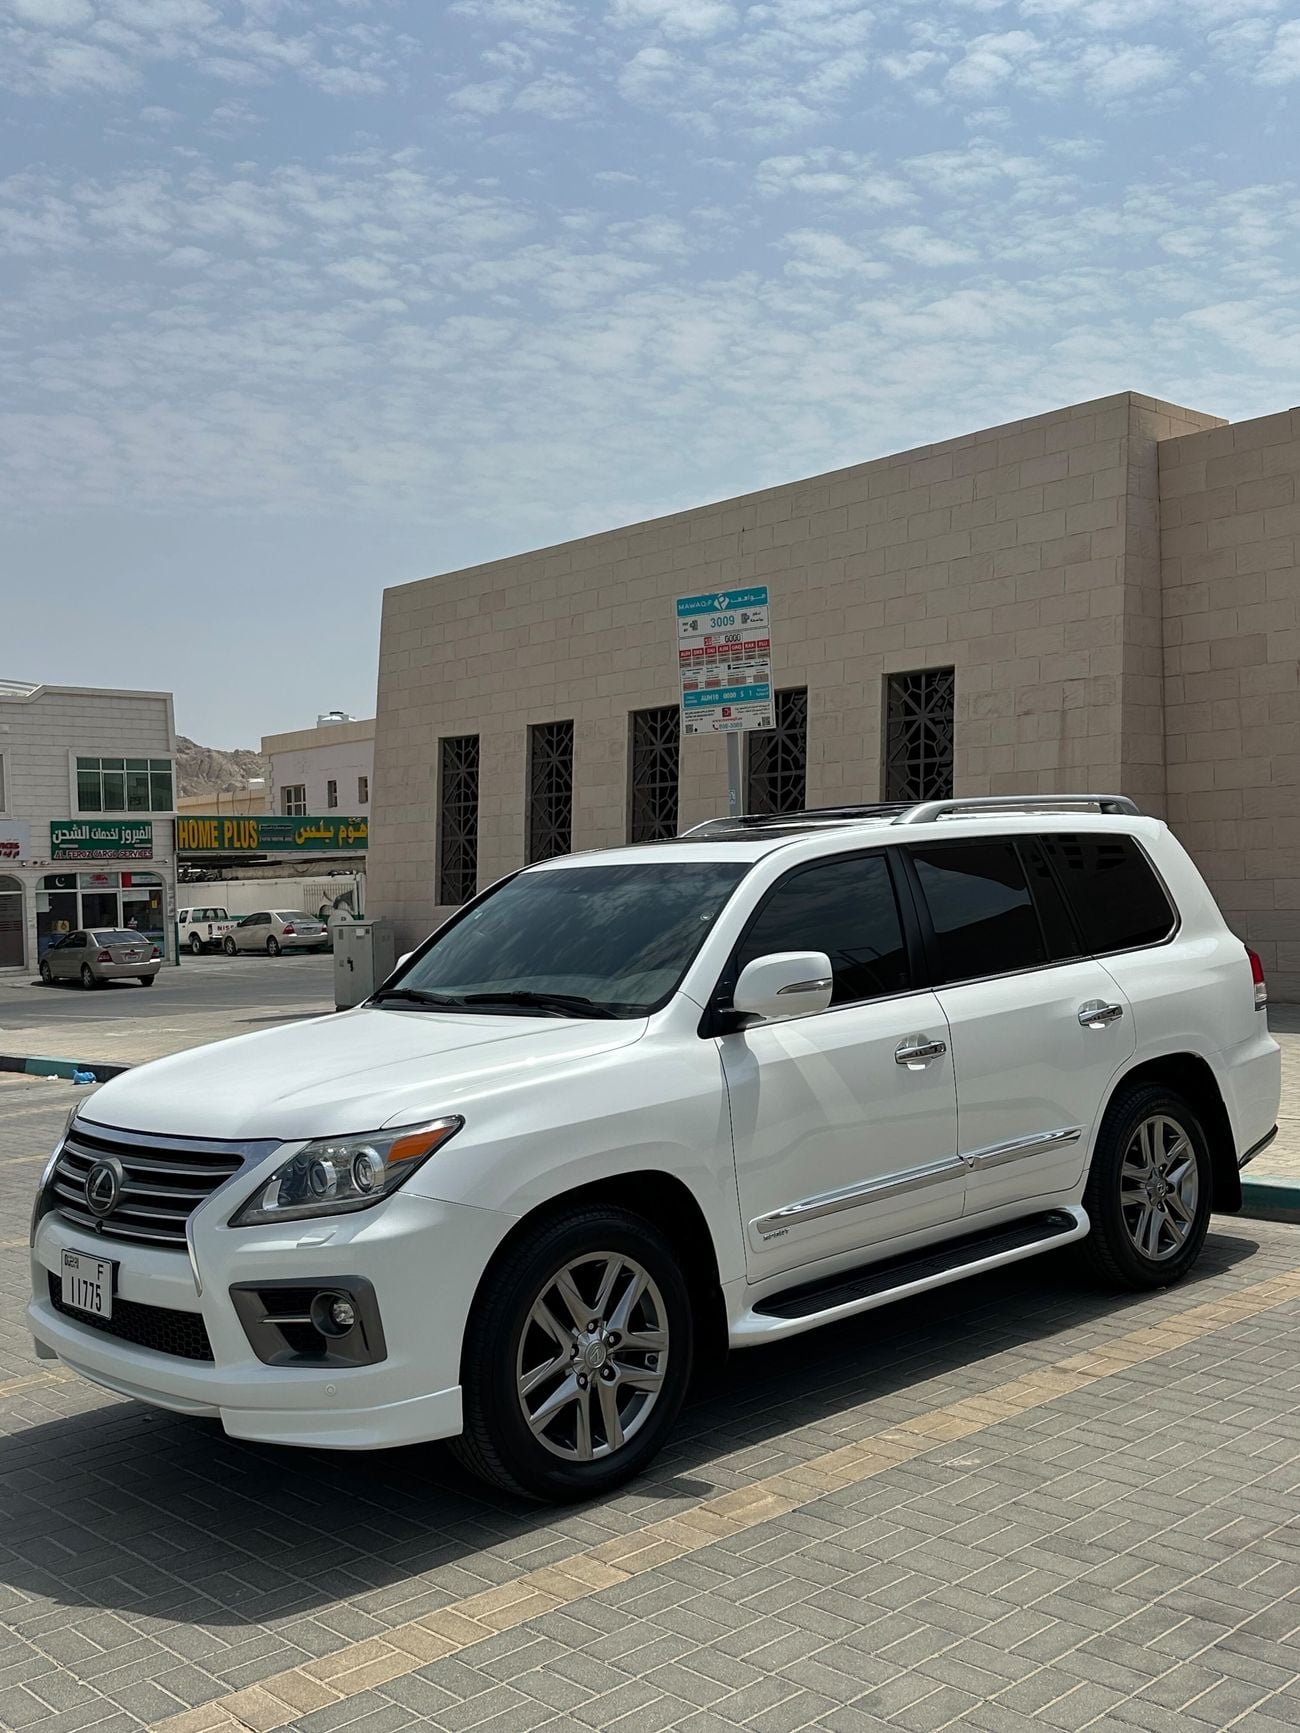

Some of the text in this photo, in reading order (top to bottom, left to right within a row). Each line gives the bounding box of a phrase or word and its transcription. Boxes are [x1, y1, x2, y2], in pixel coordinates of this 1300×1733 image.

[710, 615, 735, 628] 3009
[52, 823, 152, 844] الفيروز لخدمات الشحن
[178, 820, 219, 848] HOME
[224, 820, 258, 848] PLUS
[338, 823, 369, 848] هوم
[97, 1263, 104, 1281] F
[72, 1276, 102, 1312] 11775
